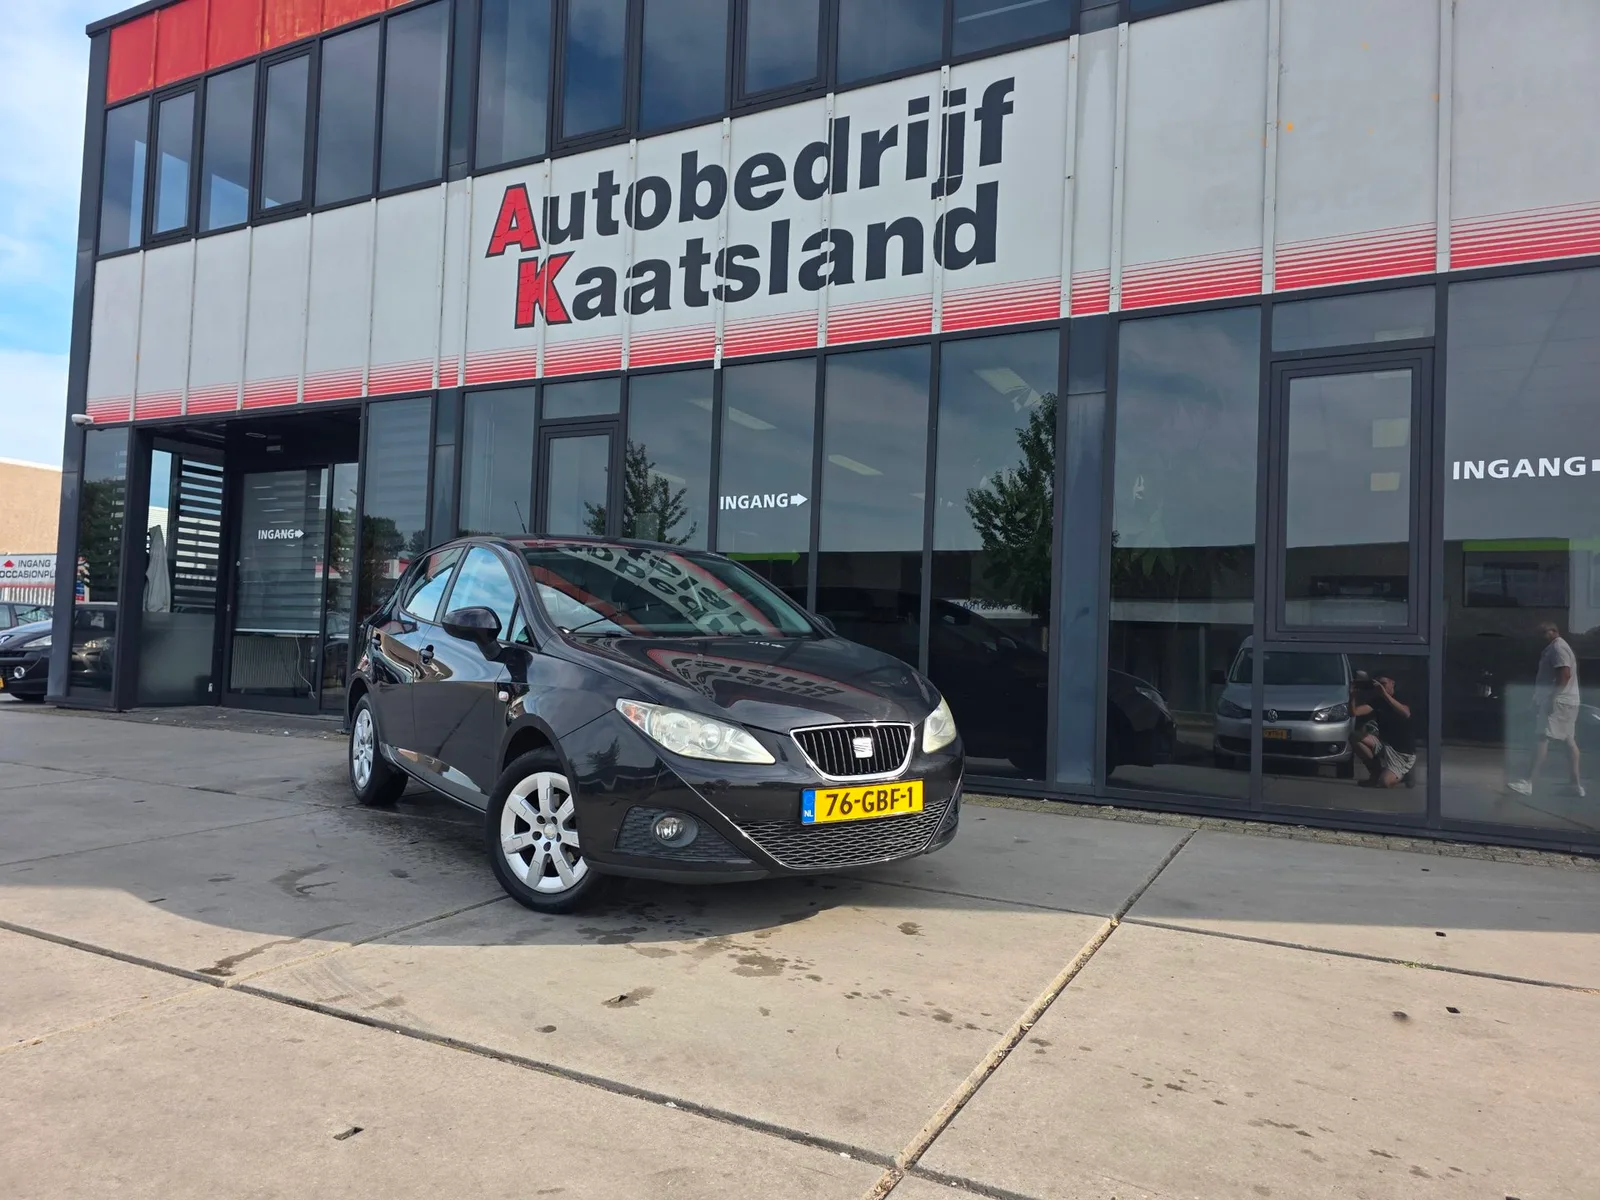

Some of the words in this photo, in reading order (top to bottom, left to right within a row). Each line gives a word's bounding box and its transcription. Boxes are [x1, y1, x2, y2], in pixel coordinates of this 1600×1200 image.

[485, 77, 1015, 258] Autobedrijf
[514, 180, 999, 329] Kaatsland
[1453, 456, 1586, 480] INGANG
[720, 493, 789, 510] INGANG
[257, 529, 295, 540] INGANG
[18, 560, 51, 568] INGANG
[826, 786, 913, 817] 76-GBF-1
[803, 809, 814, 818] NL
